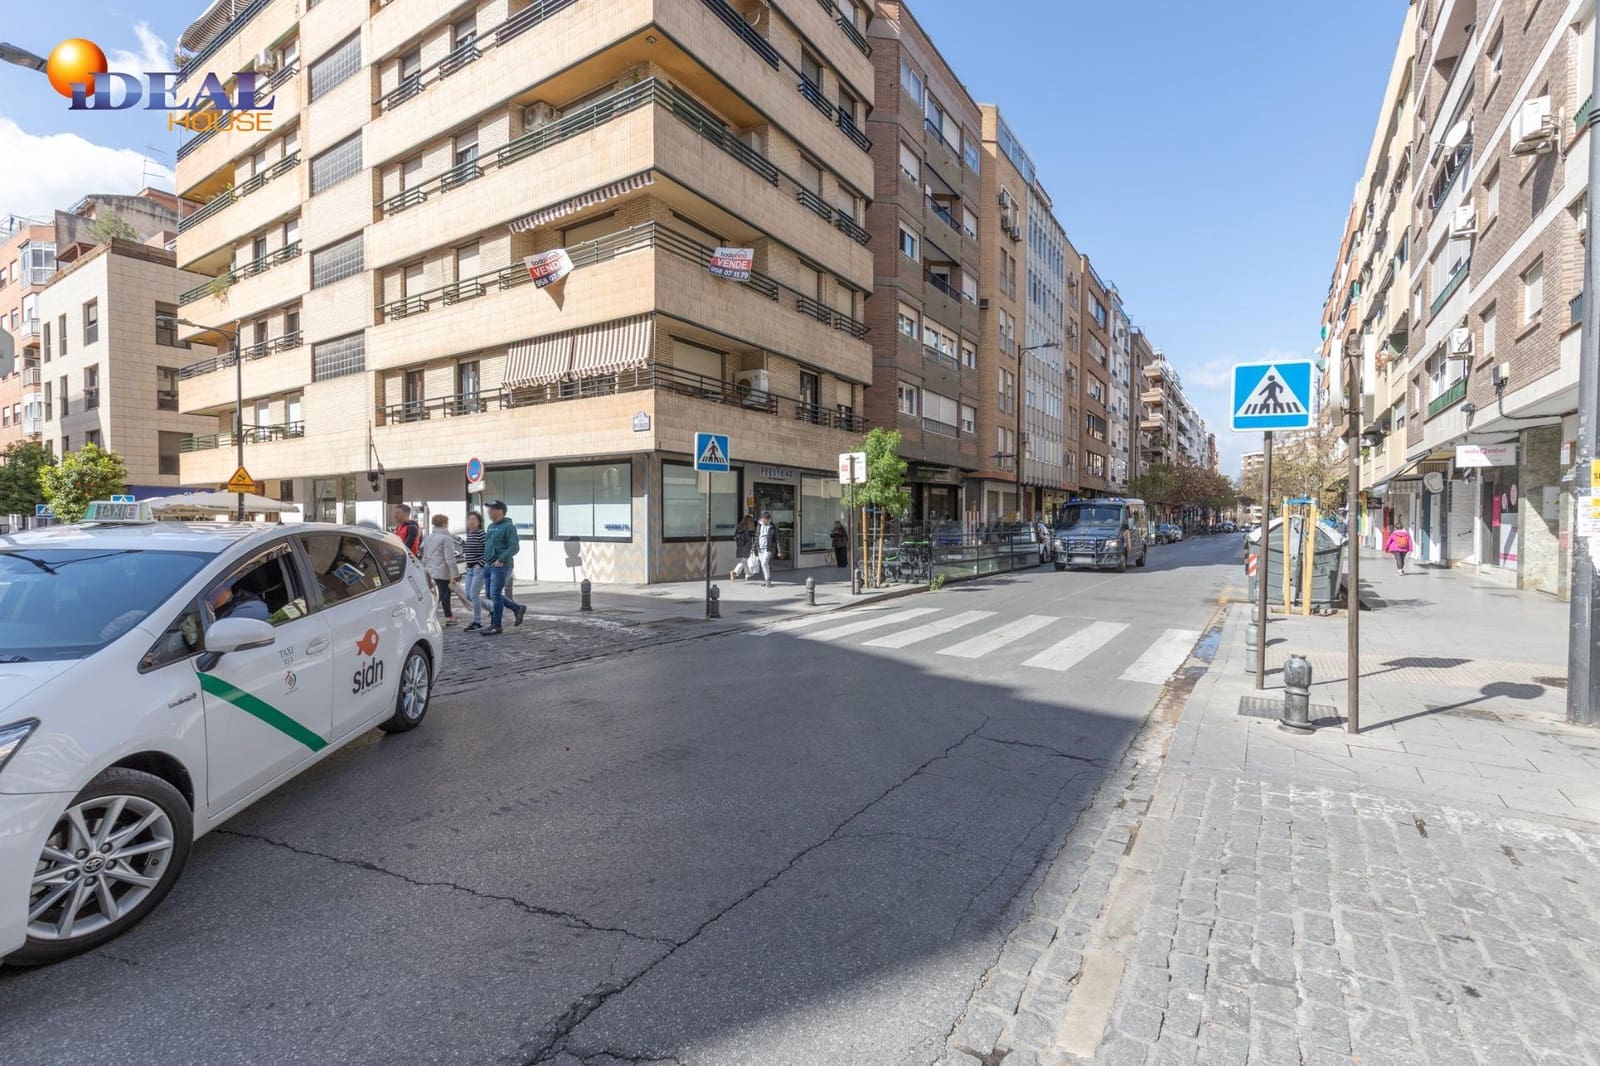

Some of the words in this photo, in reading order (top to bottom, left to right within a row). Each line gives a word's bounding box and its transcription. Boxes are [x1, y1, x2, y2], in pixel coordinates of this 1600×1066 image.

[530, 261, 562, 279] VEND
[717, 258, 747, 270] VENDE
[740, 271, 749, 279] 79
[97, 503, 124, 519] TAXI
[279, 646, 294, 658] TAXI
[352, 656, 384, 695] sidn
